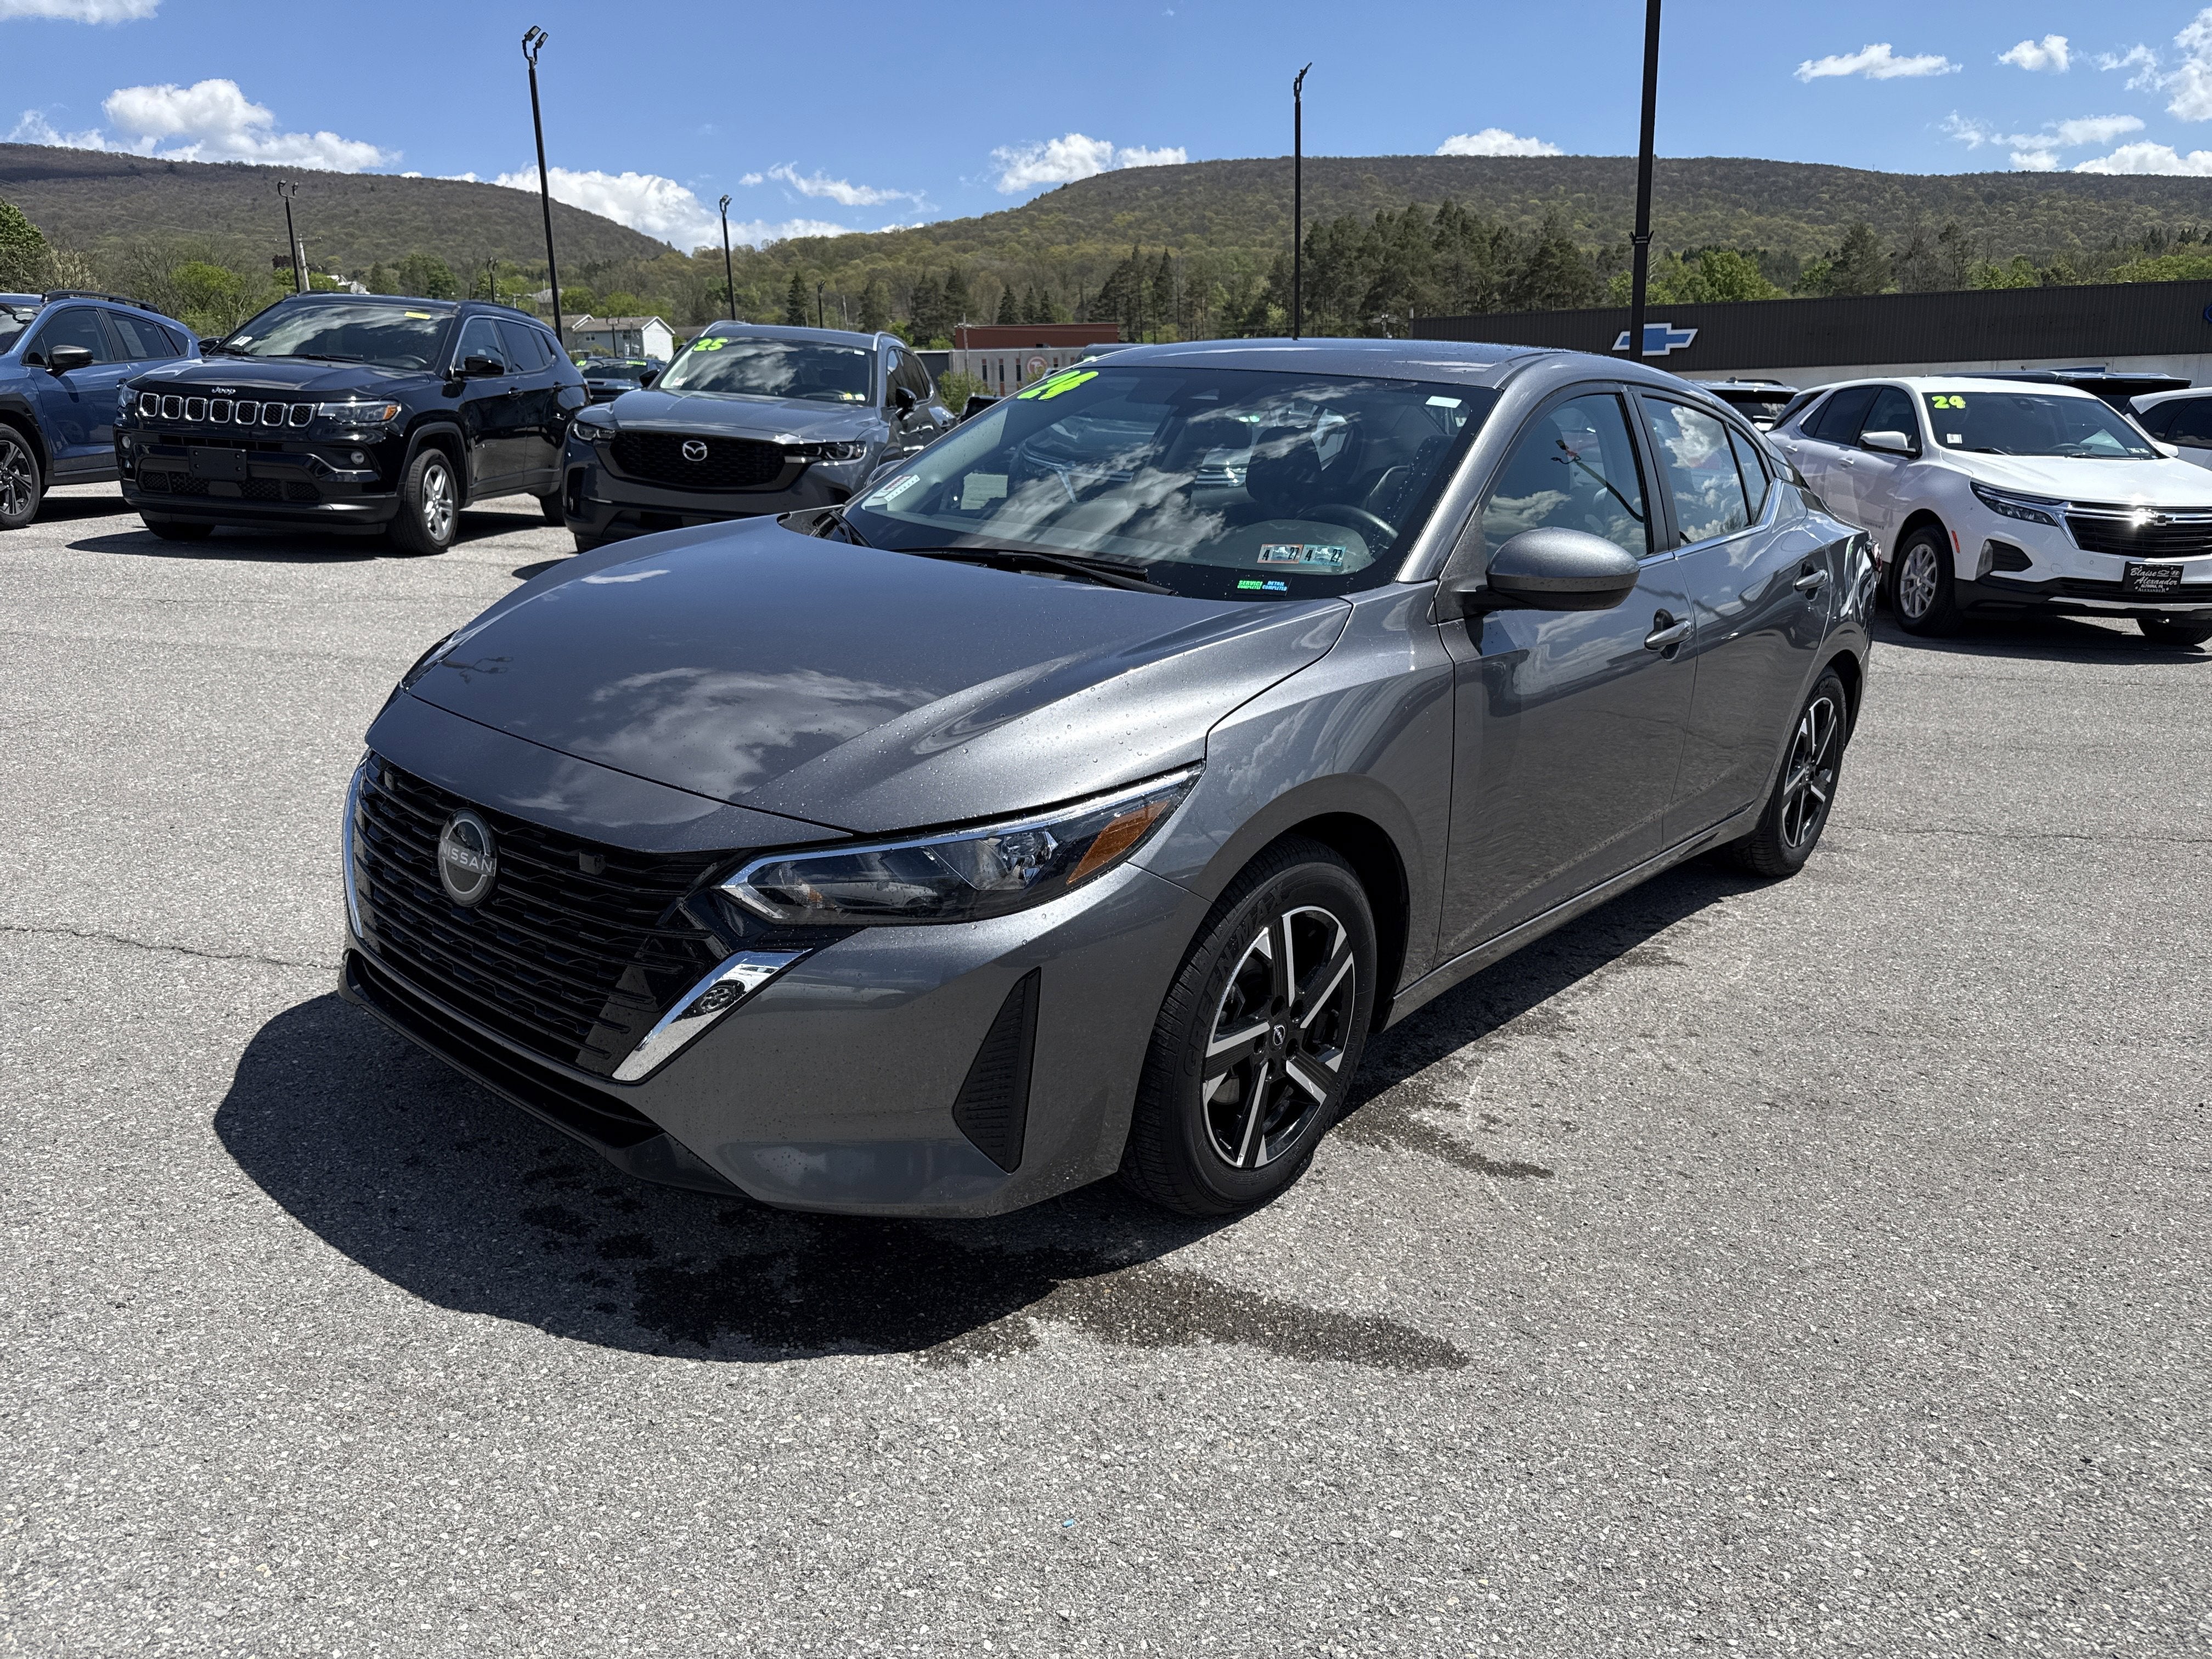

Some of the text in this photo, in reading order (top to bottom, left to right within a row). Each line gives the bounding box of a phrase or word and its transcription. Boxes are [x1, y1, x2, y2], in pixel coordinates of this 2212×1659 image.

[693, 338, 728, 351] 25
[212, 386, 236, 395] Jeep
[1932, 396, 1966, 409] 24
[1263, 547, 1299, 561] 4 27
[1305, 549, 1342, 562] 4 27
[2134, 576, 2177, 585] Alexander
[441, 841, 493, 873] NISSAN
